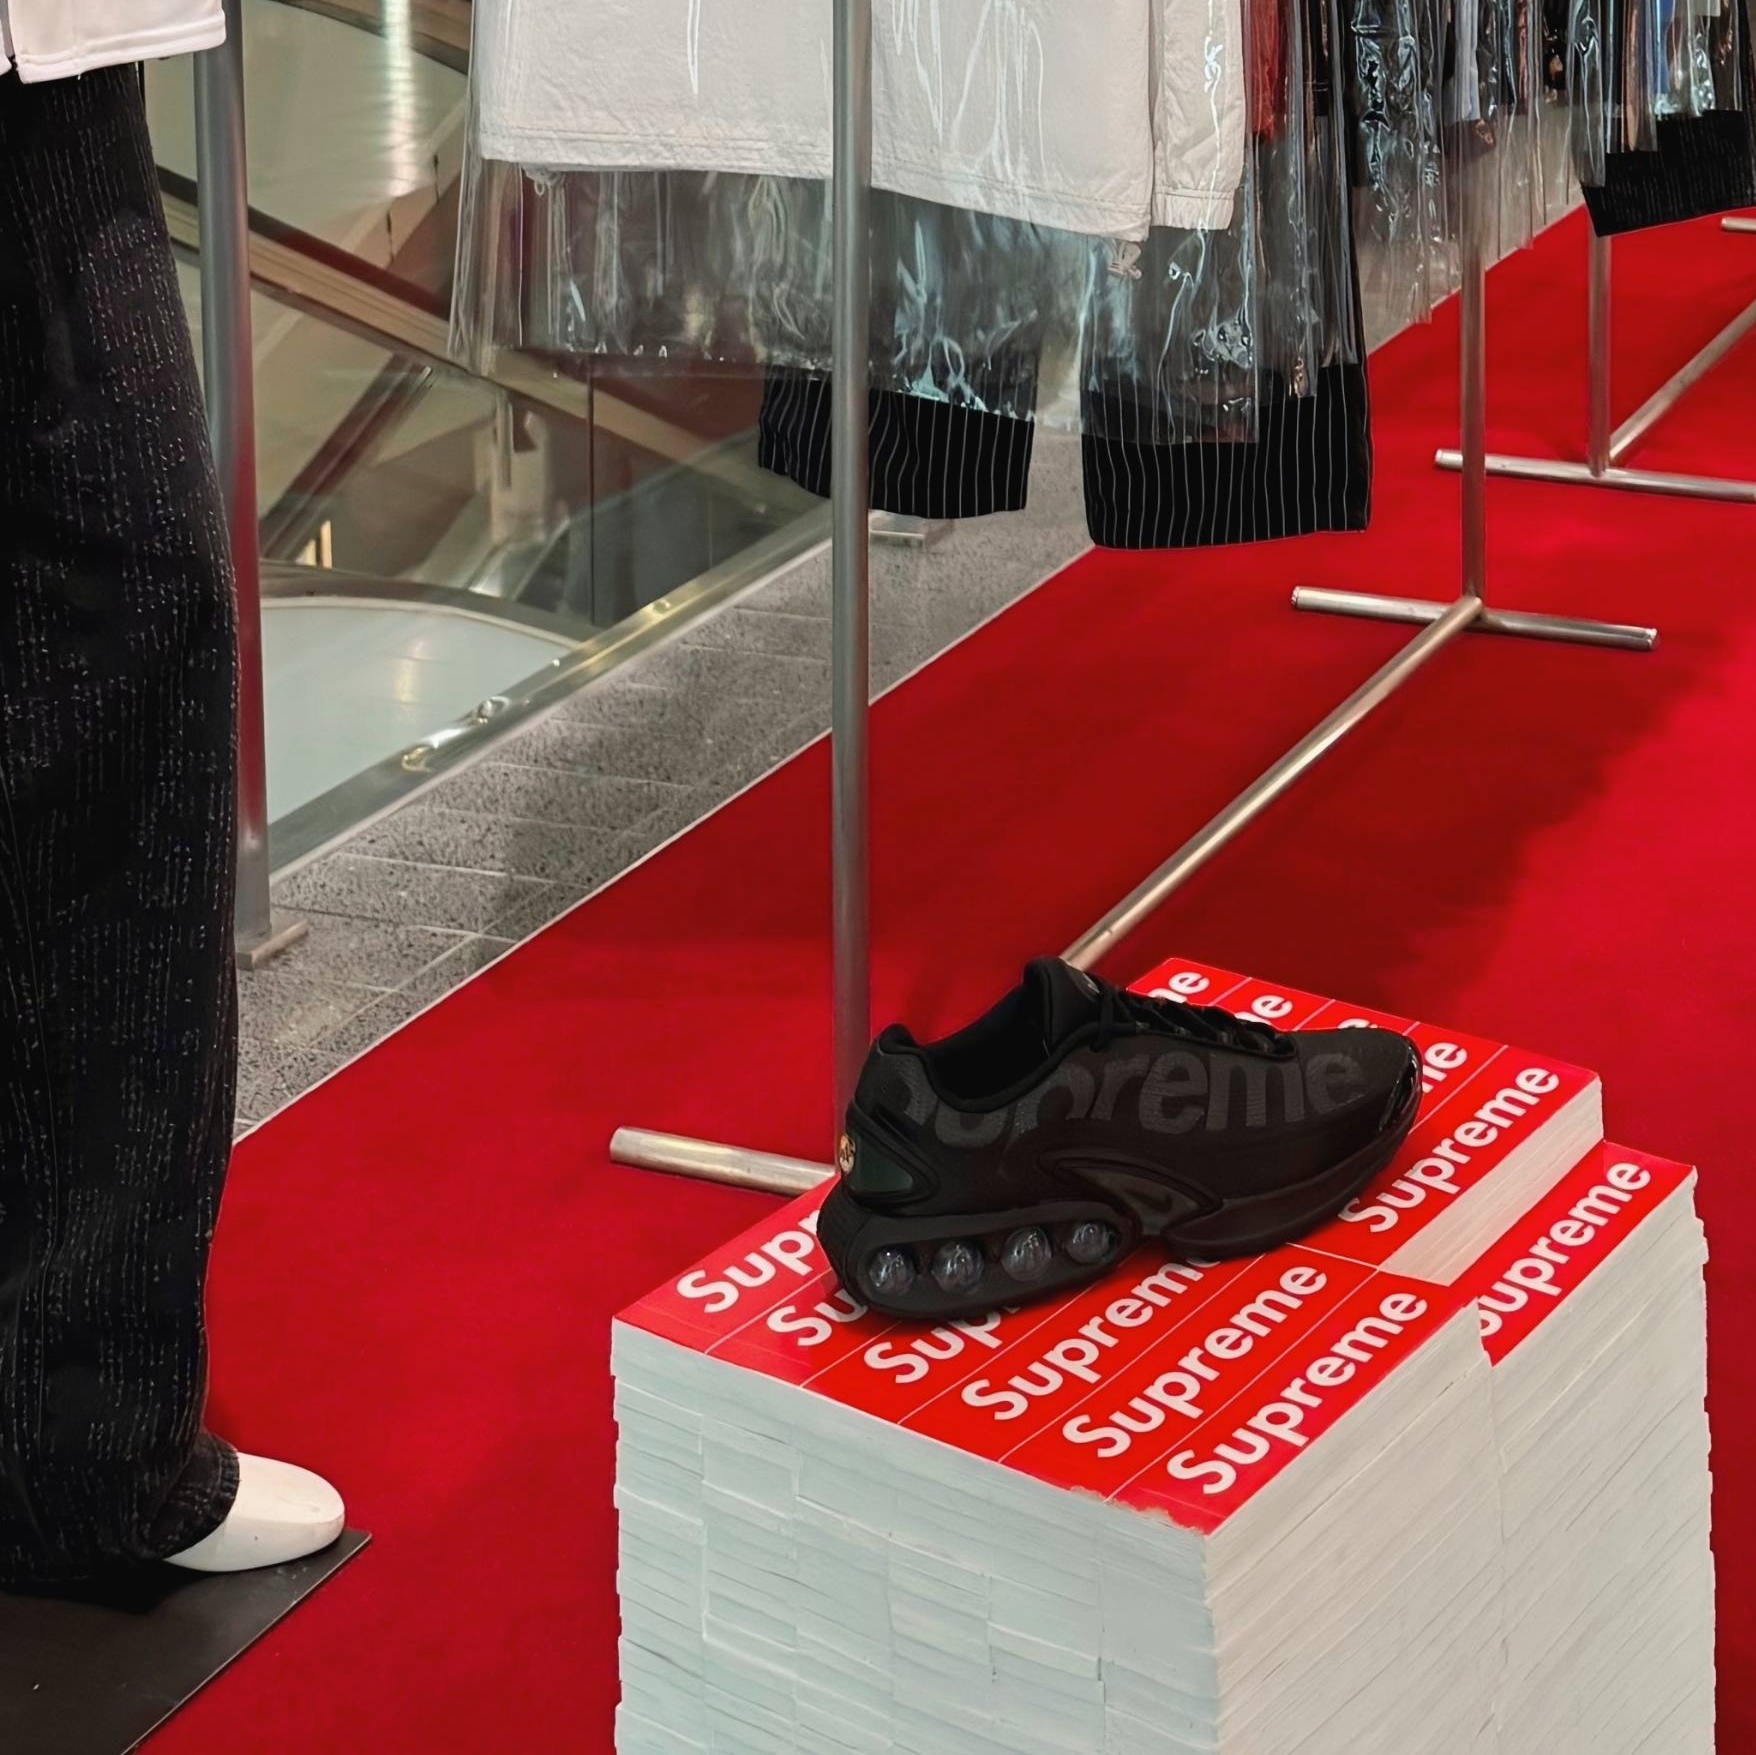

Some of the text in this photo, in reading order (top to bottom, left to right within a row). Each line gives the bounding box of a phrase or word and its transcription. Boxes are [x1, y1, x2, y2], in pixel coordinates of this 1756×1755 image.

[1338, 1067, 1559, 1233] Supreme
[961, 1259, 1221, 1420] Suprem
[1062, 1266, 1327, 1458] Supreme
[1167, 1292, 1427, 1494] Supreme
